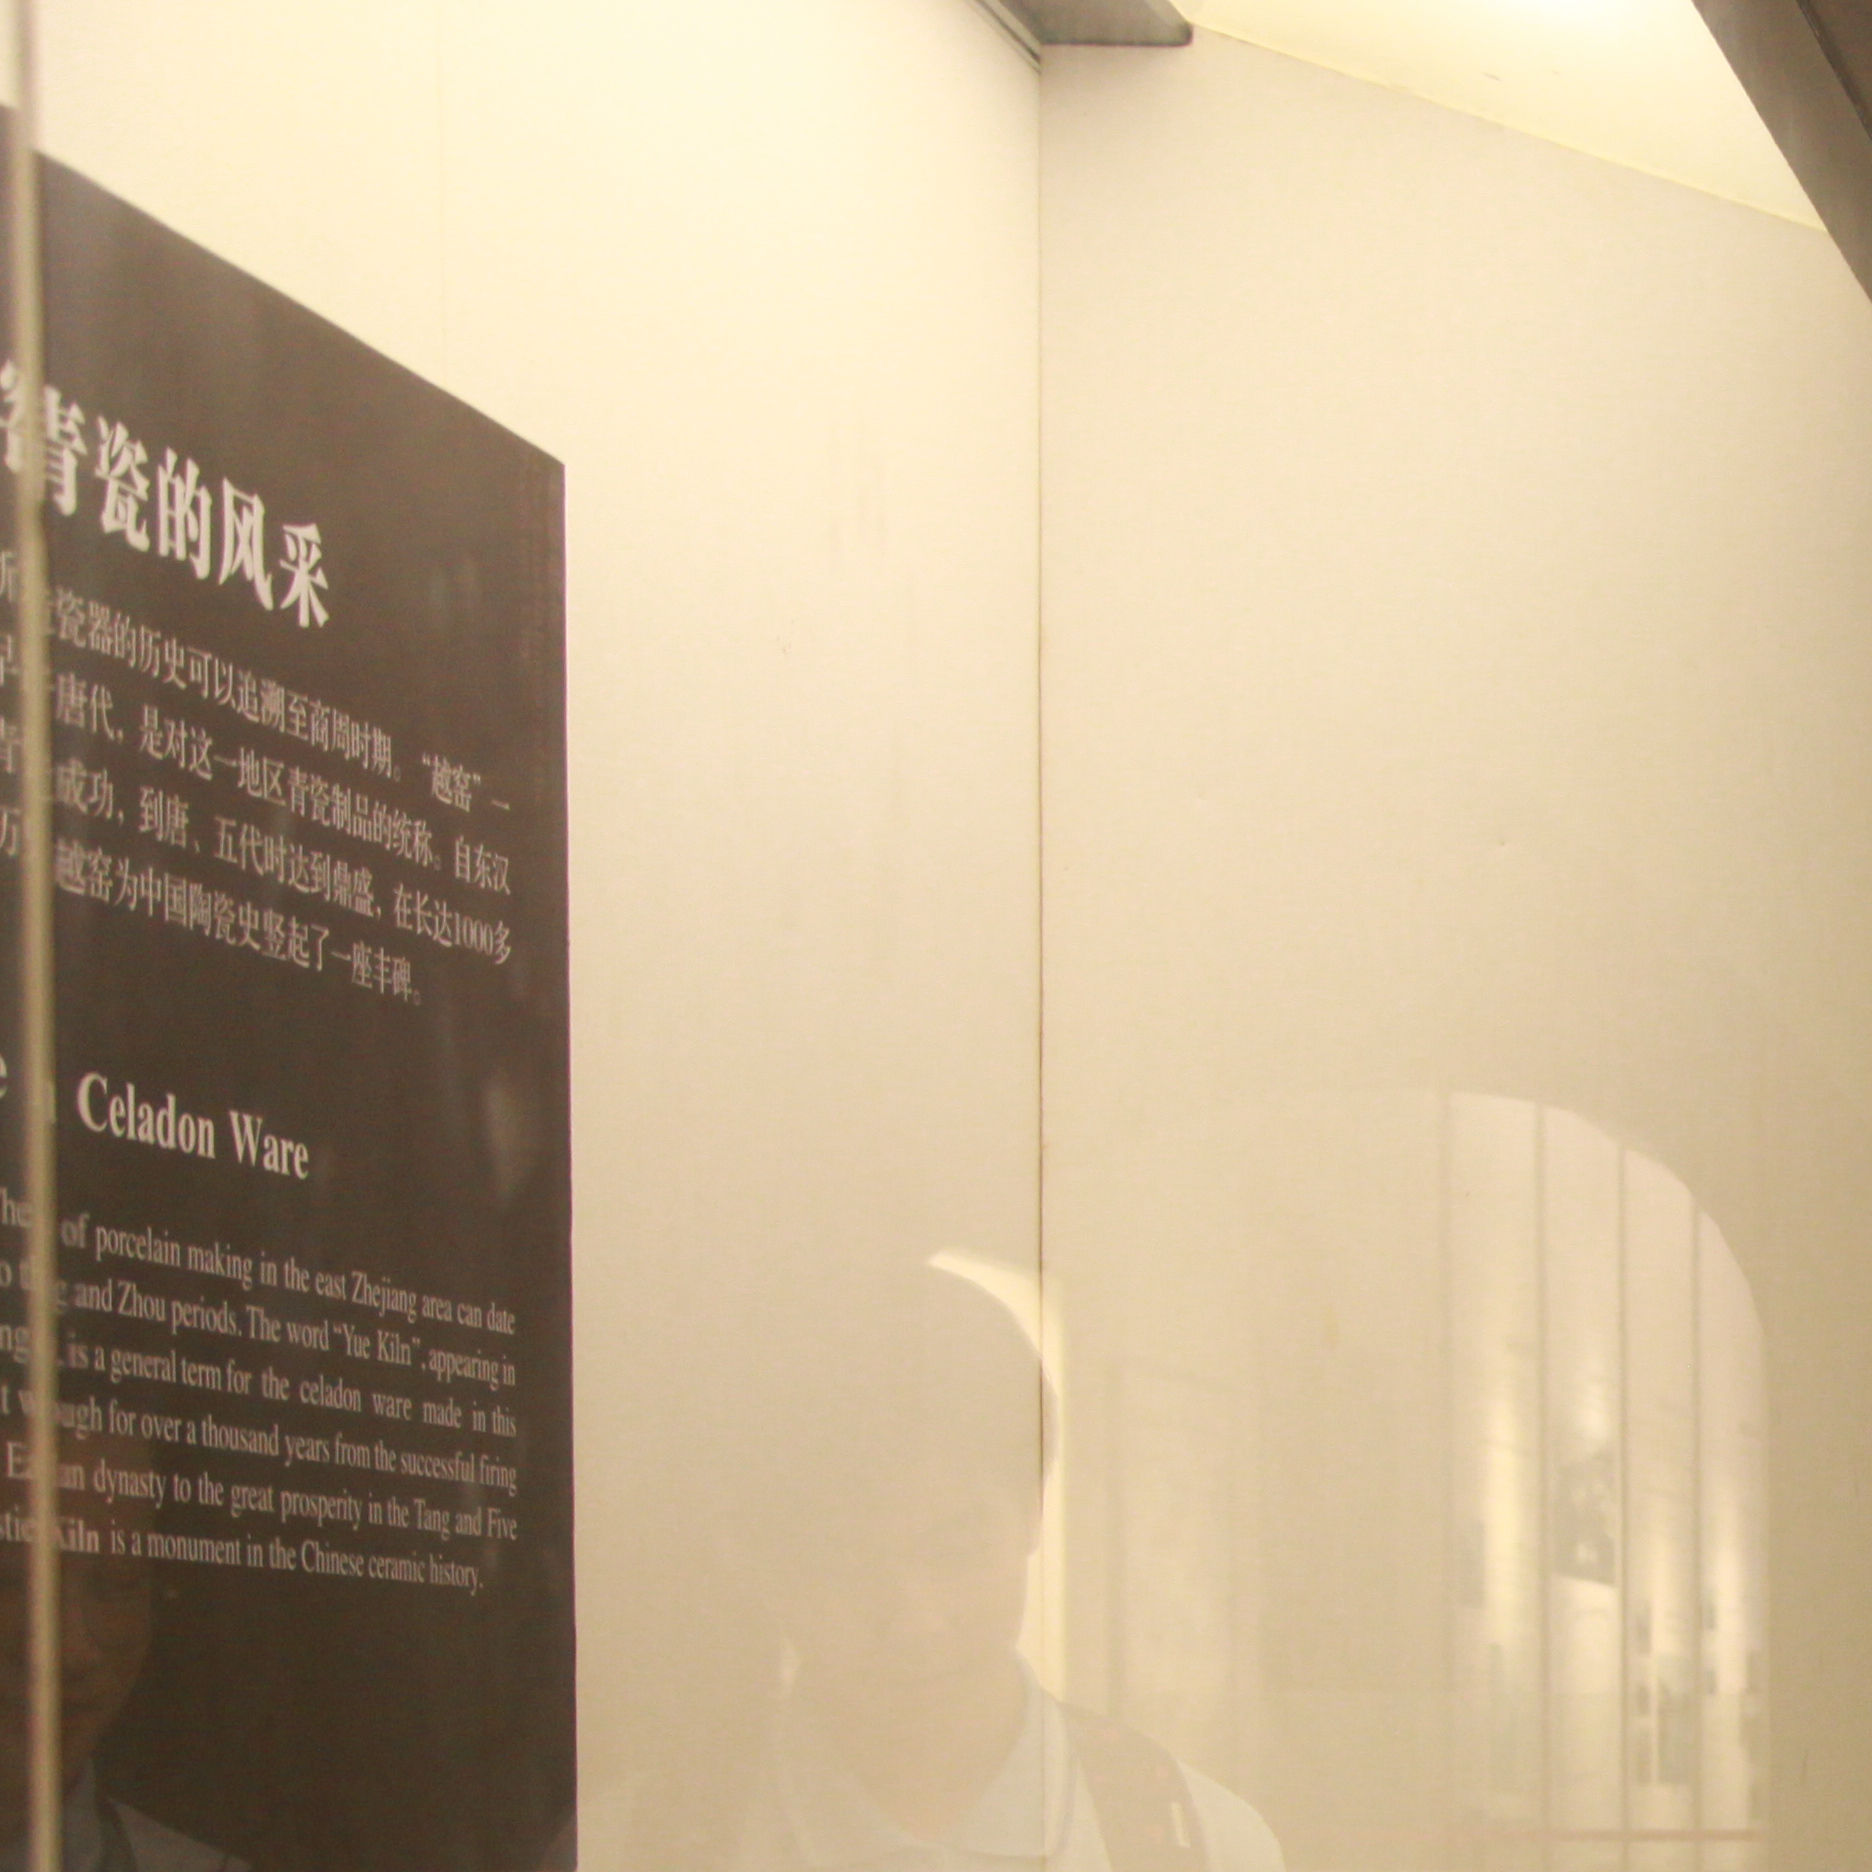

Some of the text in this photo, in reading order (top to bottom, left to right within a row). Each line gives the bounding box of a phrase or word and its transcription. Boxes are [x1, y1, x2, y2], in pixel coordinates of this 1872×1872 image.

[77, 1071, 216, 1159] Celadon
[228, 1109, 310, 1180] Ware
[61, 1212, 90, 1249] of
[95, 1225, 182, 1268] porcelain
[187, 1241, 253, 1292] making
[260, 1251, 278, 1287] in
[283, 1255, 310, 1293] the
[315, 1270, 348, 1301] east
[351, 1269, 418, 1324] Zhejiang
[422, 1295, 453, 1323] area
[457, 1301, 483, 1329] can
[486, 1302, 516, 1335] date
[66, 1329, 89, 1369] is
[94, 1343, 106, 1372] a
[110, 1348, 177, 1384] general
[181, 1356, 223, 1392] term
[227, 1358, 252, 1395] for
[261, 1365, 290, 1401] the
[299, 1373, 362, 1413] celadon
[371, 1392, 413, 1421] ware
[422, 1397, 462, 1429] made
[472, 1400, 487, 1433] in
[492, 1406, 517, 1438] this
[74, 1278, 113, 1313] and
[118, 1280, 166, 1322] Zhou
[171, 1296, 242, 1336] periods.
[246, 1304, 281, 1343] The
[286, 1319, 330, 1351] word
[332, 1322, 371, 1360] “Yue
[429, 1348, 499, 1392] appearing
[503, 1353, 516, 1387] in
[93, 1457, 168, 1510] dynasty
[172, 1471, 192, 1504] to
[197, 1470, 225, 1507] the
[230, 1482, 275, 1519] great
[279, 1487, 364, 1532] prosperity
[368, 1491, 384, 1526] in
[386, 1494, 411, 1530] the
[413, 1496, 451, 1542] Tang
[454, 1506, 483, 1537] and
[486, 1506, 518, 1542] Five
[108, 1397, 137, 1437] for
[140, 1414, 183, 1443] over
[186, 1419, 198, 1446] a
[201, 1413, 280, 1457] thousand
[283, 1432, 331, 1468] years
[334, 1430, 371, 1469] from
[373, 1438, 397, 1473] the
[400, 1449, 476, 1485] successful
[478, 1453, 517, 1498] firing
[110, 1518, 127, 1556] is
[131, 1530, 143, 1557] a
[146, 1528, 243, 1567] monument
[246, 1532, 264, 1569] in
[268, 1535, 297, 1572] the
[300, 1538, 365, 1578] Chinese
[367, 1550, 426, 1584] ceramic
[429, 1553, 484, 1598] history.
